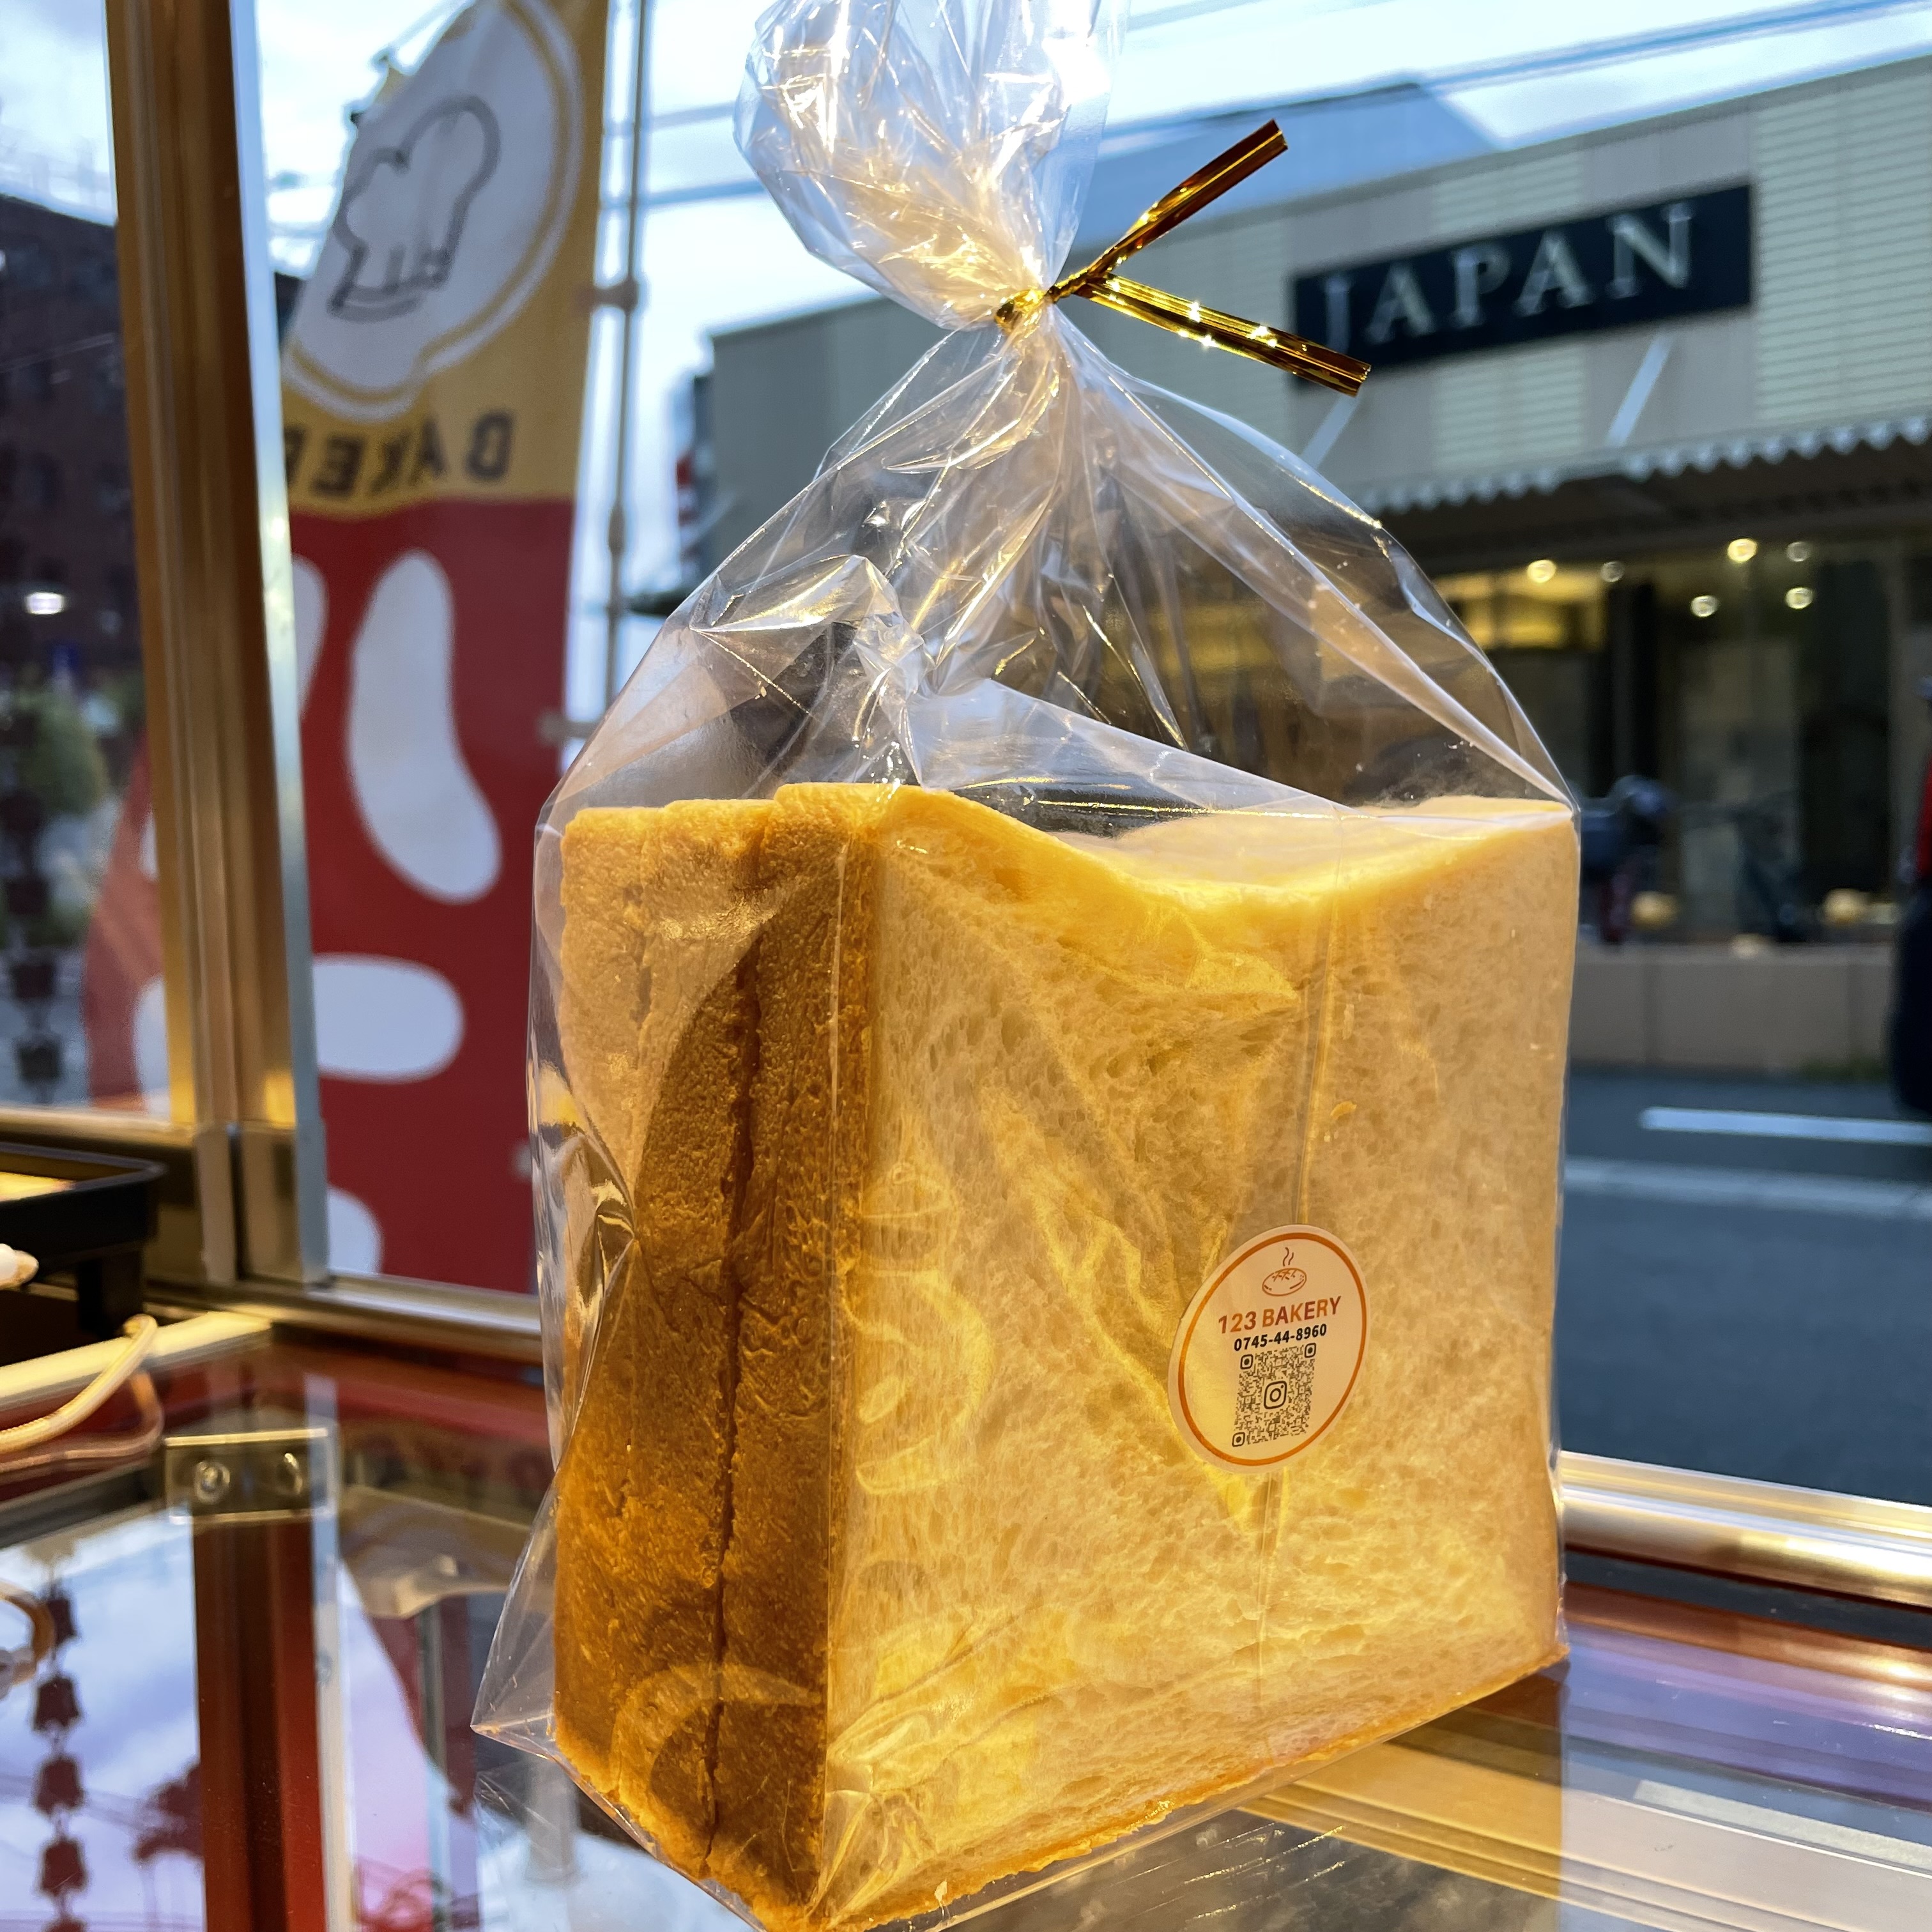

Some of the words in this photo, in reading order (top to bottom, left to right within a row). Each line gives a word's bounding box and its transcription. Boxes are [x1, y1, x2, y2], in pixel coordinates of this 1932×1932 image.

[1322, 203, 1694, 356] JAPAN
[1218, 1310, 1257, 1335] 123
[1262, 1296, 1342, 1328] BAKERY
[1234, 1323, 1327, 1351] 0745-44-8960
